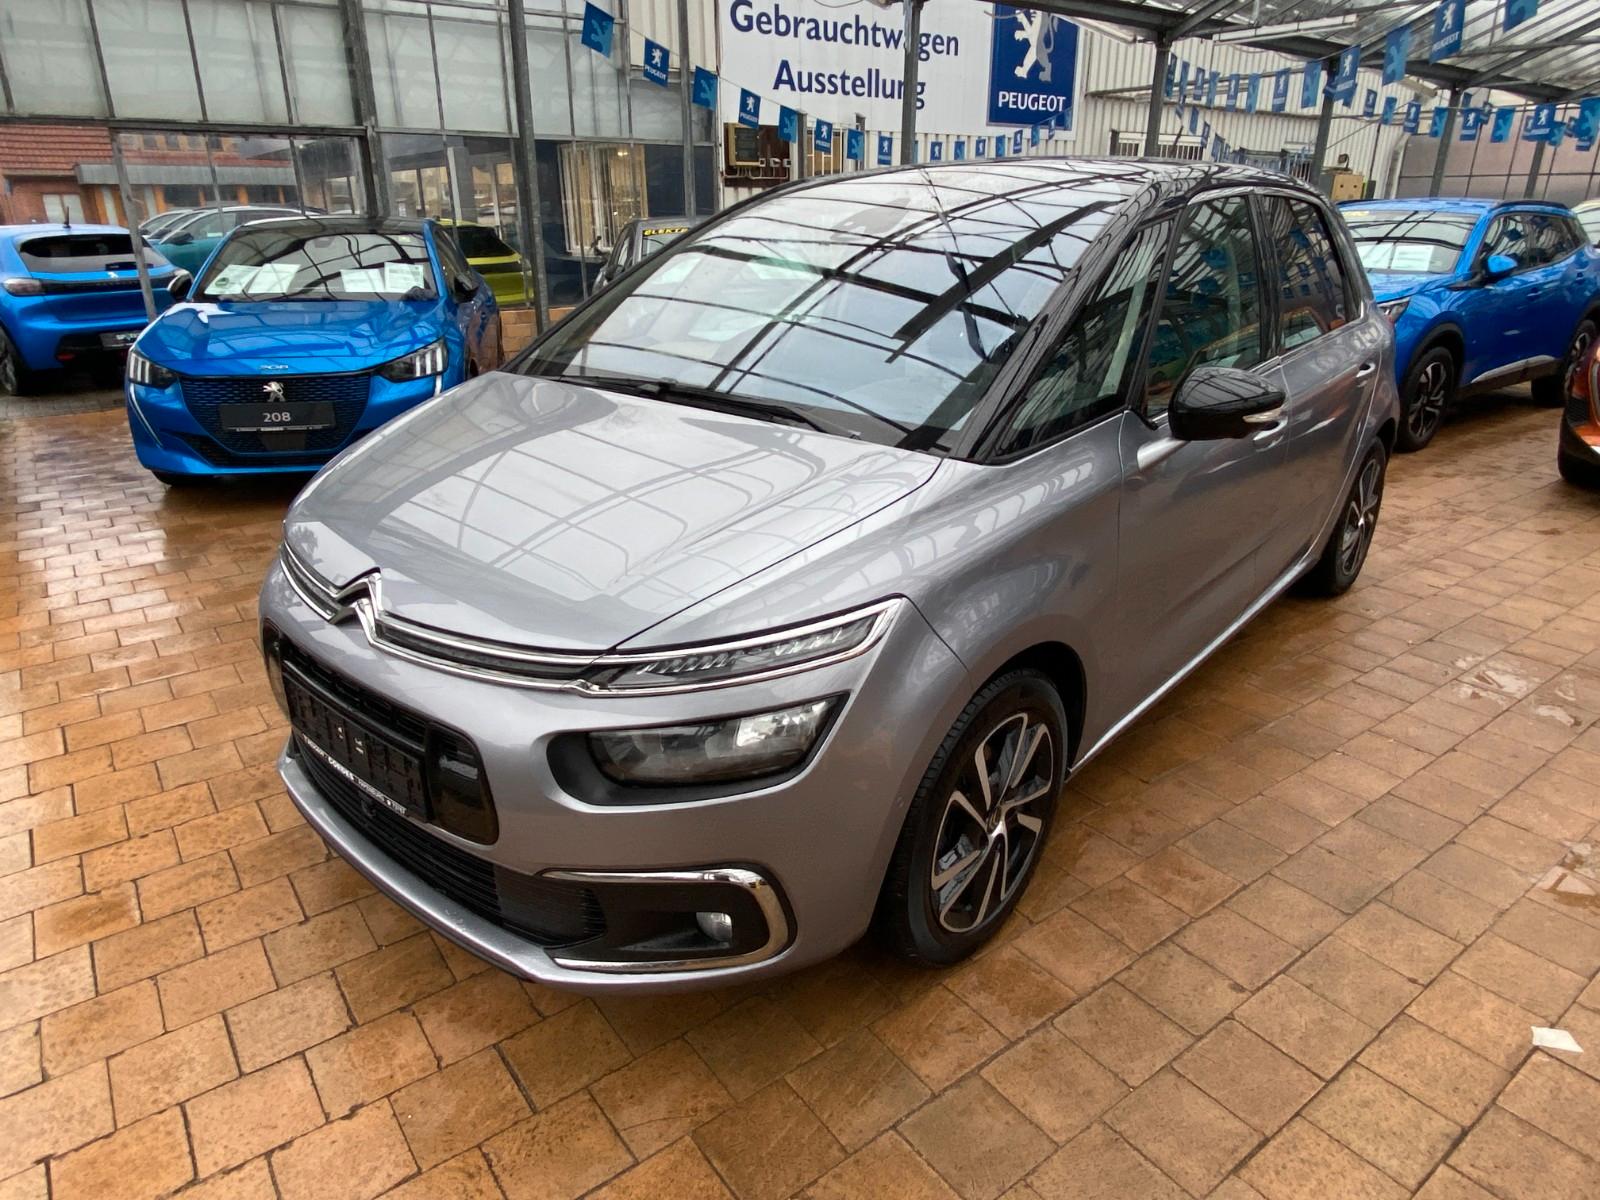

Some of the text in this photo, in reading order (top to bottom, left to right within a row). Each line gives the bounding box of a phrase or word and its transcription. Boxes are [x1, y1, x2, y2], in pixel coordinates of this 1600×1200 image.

[730, 0, 959, 61] Gebrauchtwgen
[998, 91, 1067, 112] PEUGEOT
[263, 411, 291, 423] 208
